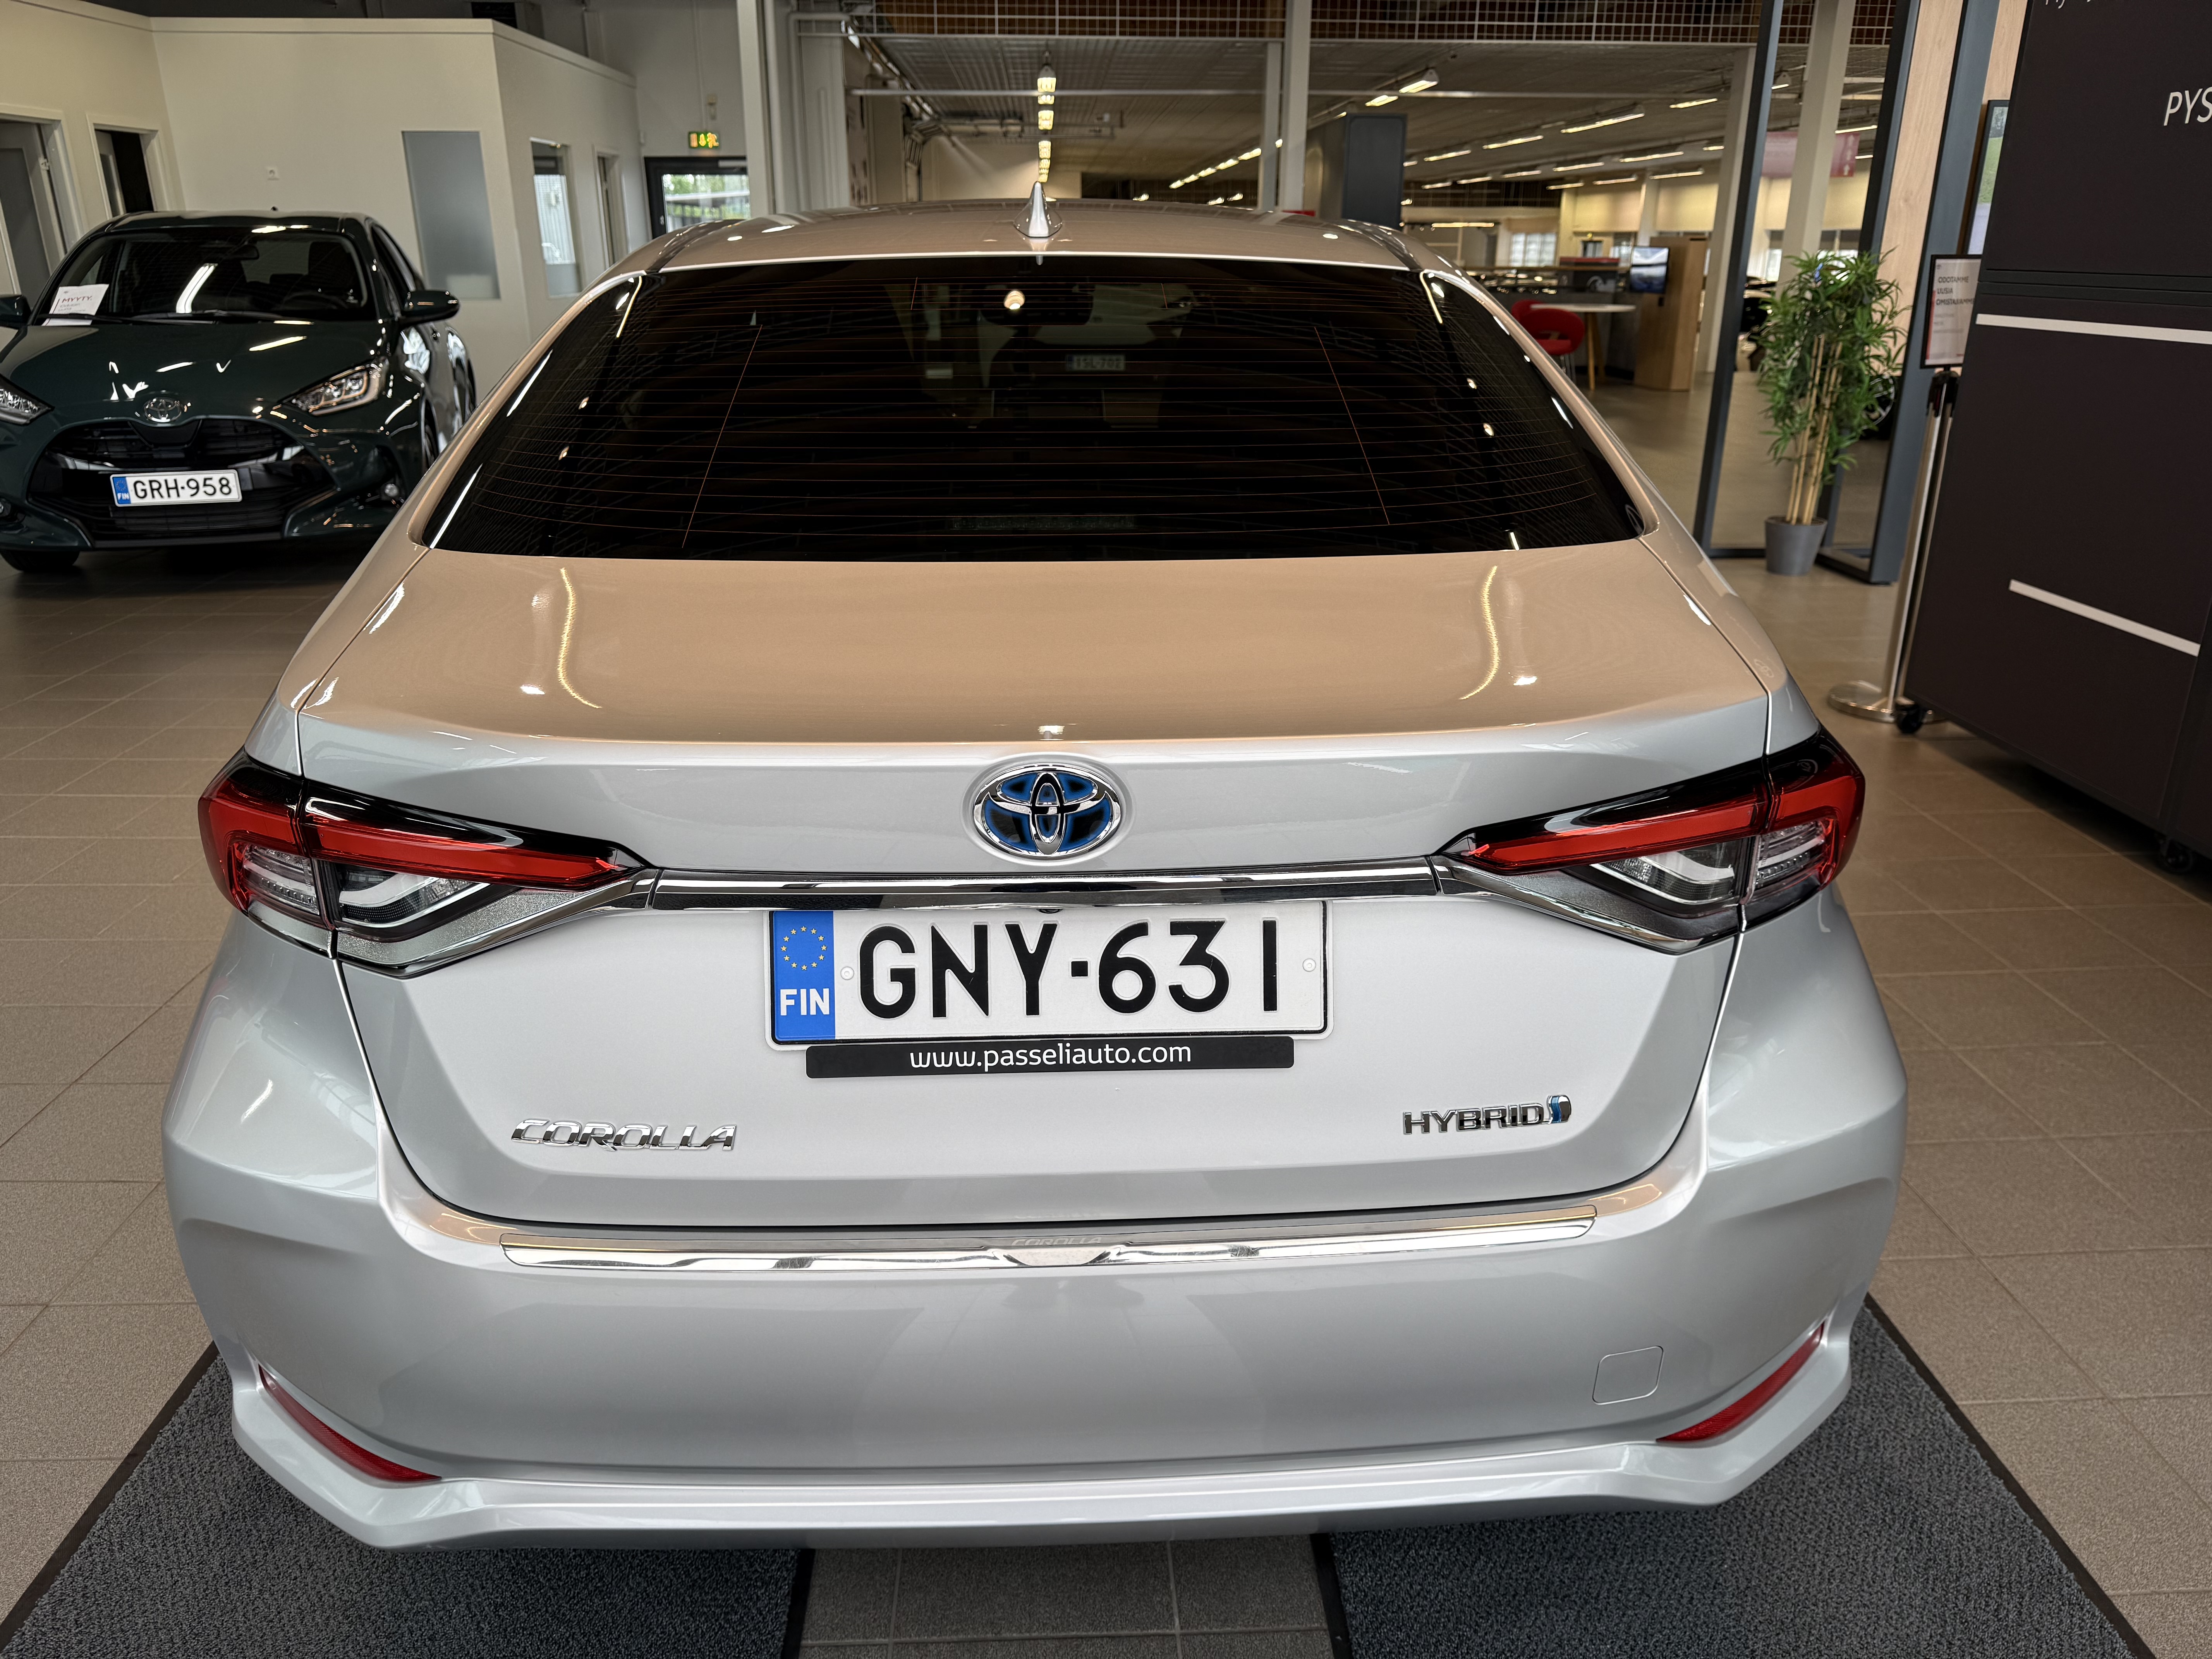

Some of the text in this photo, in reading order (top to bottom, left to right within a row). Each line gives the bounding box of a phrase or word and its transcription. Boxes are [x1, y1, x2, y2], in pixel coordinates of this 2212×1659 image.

[2164, 86, 2212, 126] PYS
[133, 477, 232, 499] GRH-958
[780, 917, 1278, 1019] FIN GNY-631
[910, 1042, 1192, 1072] www.passeliauto.com
[511, 1118, 737, 1152] COROLLA
[1403, 1103, 1545, 1135] HYBRID
[1012, 1237, 1102, 1246] COROLLA
